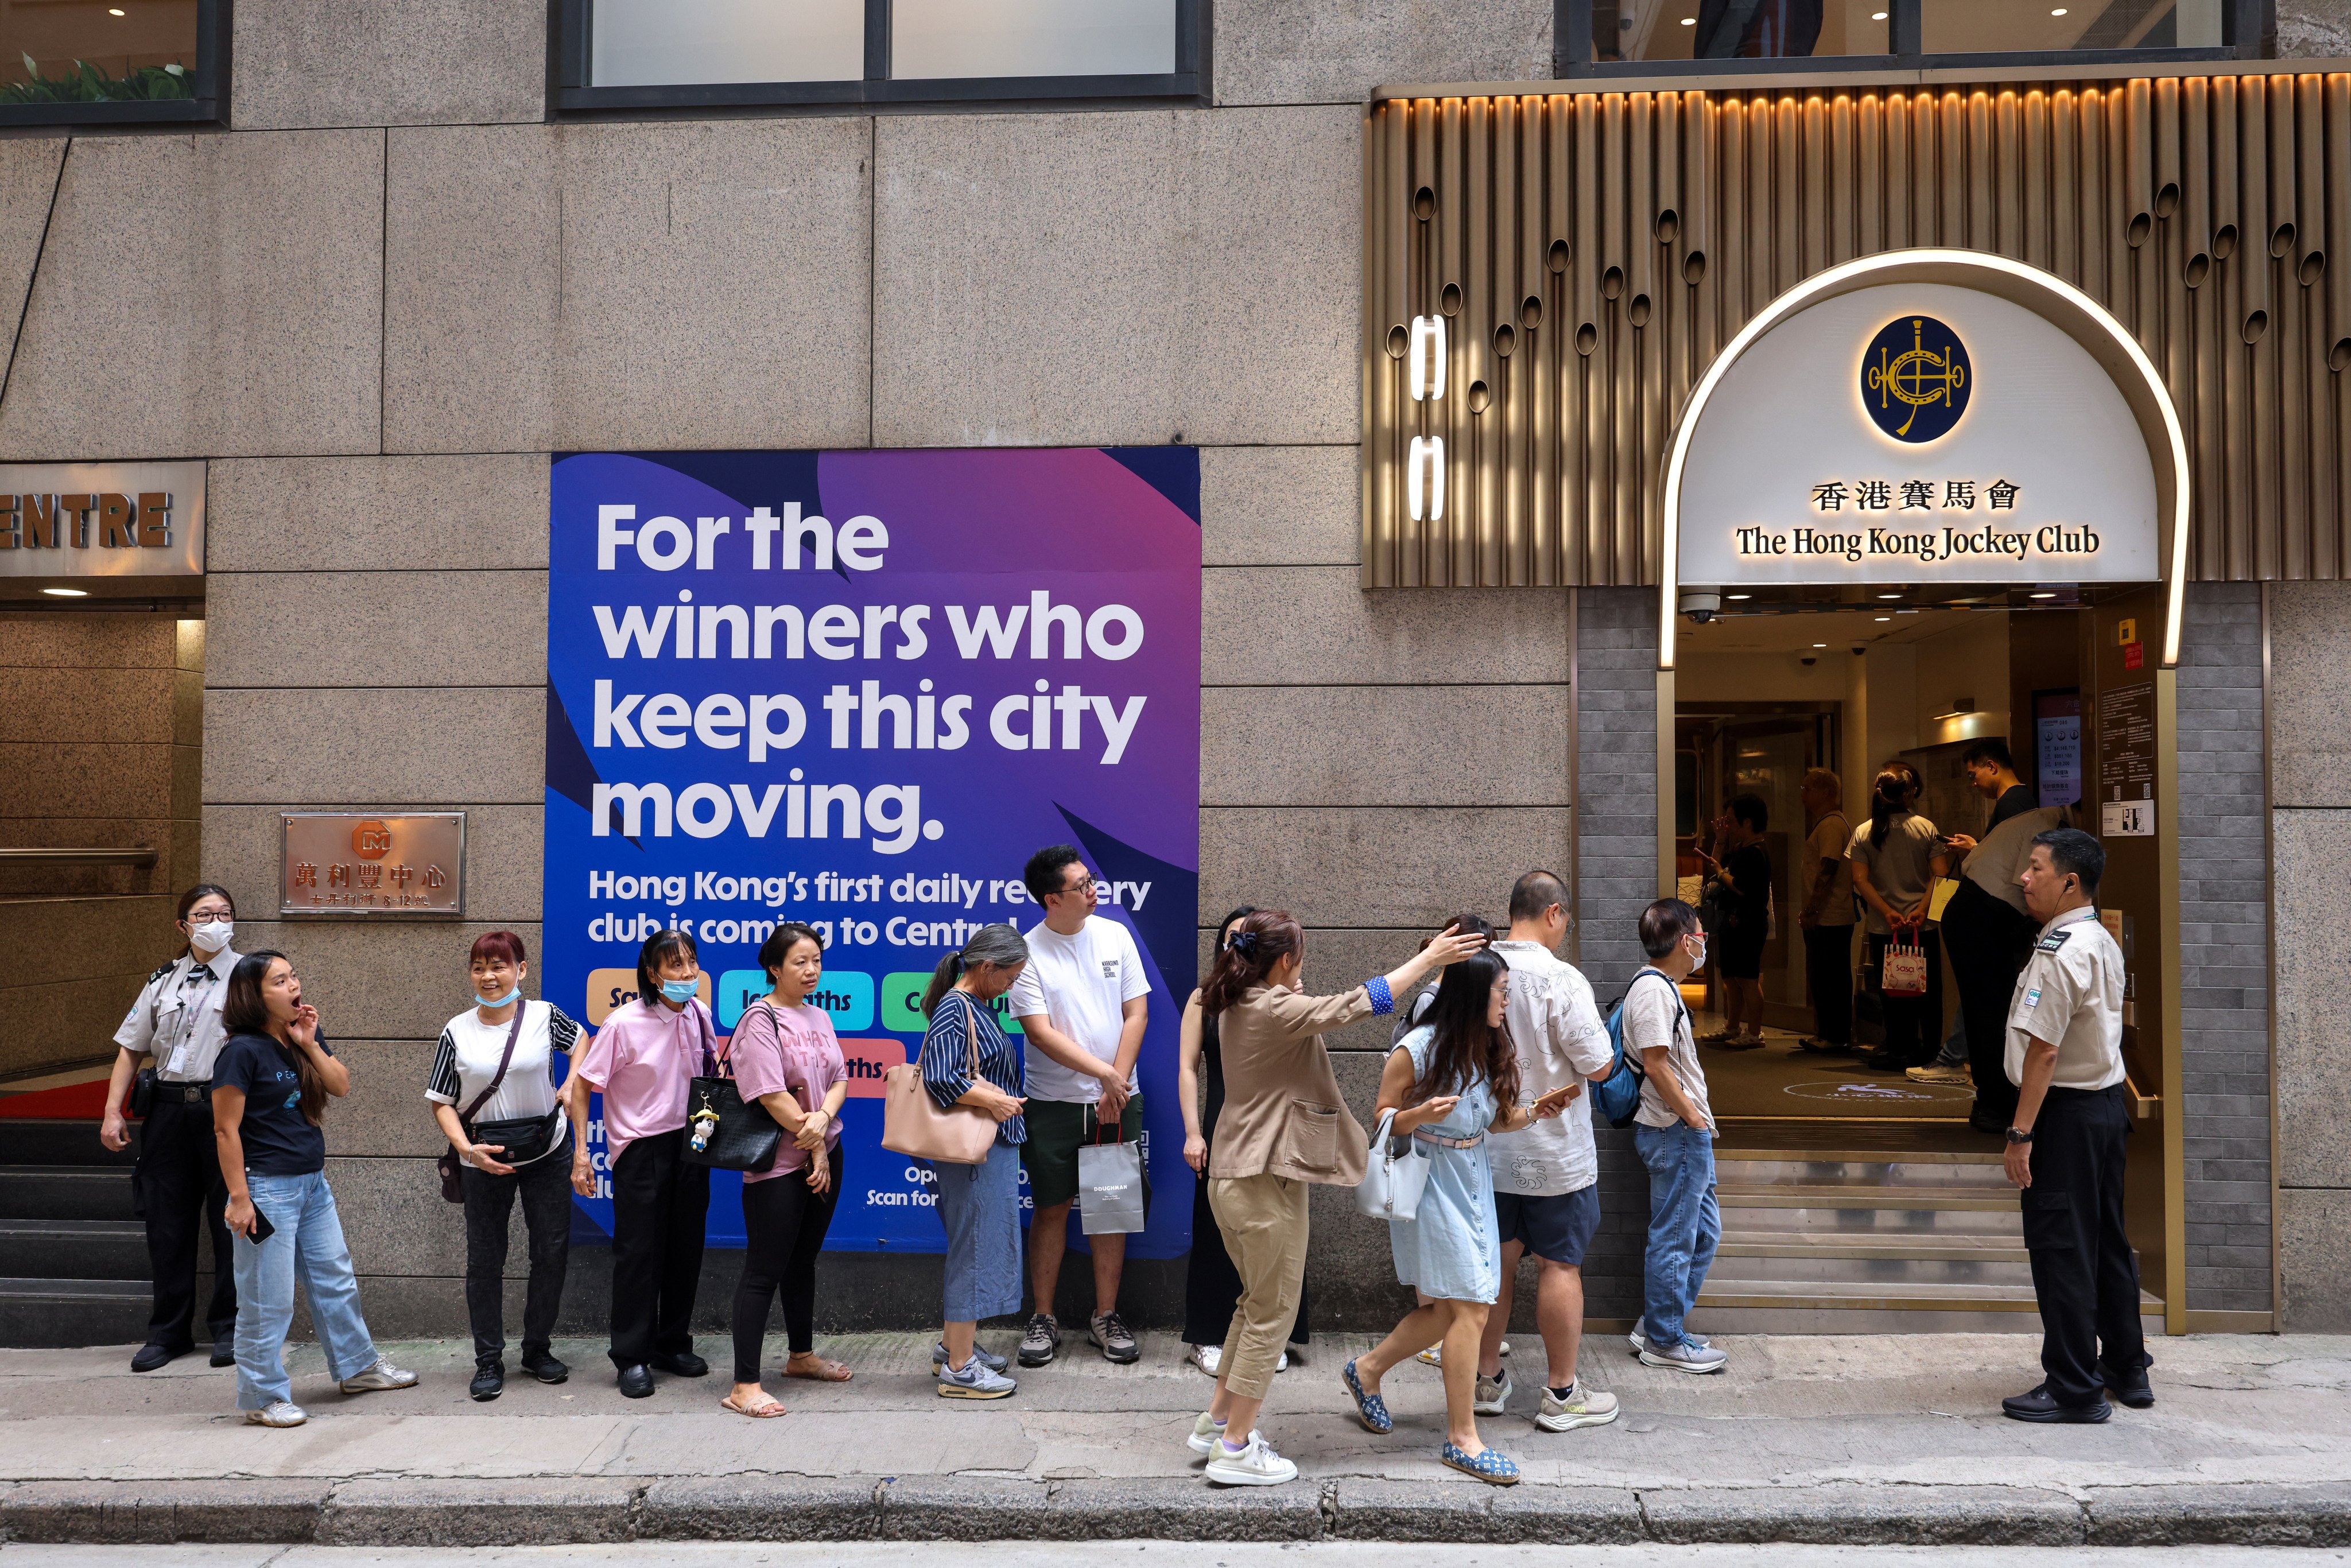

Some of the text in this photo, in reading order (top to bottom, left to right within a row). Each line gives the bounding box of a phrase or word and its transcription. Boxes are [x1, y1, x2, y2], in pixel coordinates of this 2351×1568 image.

[1811, 479, 2022, 511] 香港賽馬會
[598, 502, 889, 572] For the
[1736, 524, 2099, 562] The Hong Kong Jockey Club
[592, 589, 1144, 661] winners who
[593, 678, 1148, 764] keep this city
[592, 767, 944, 855] moving.
[296, 862, 446, 890] 萬利豐中心
[589, 870, 686, 906] Hong
[814, 871, 884, 902] first
[890, 872, 984, 909] daily
[990, 880, 1152, 911] reery
[588, 913, 662, 942] club
[669, 913, 693, 936] is
[700, 914, 833, 950] comg
[840, 917, 878, 945] to
[781, 1030, 831, 1048] WHAT
[867, 1189, 939, 1206] Scan for
[1093, 1184, 1128, 1192] DOUGHMAN
[1563, 1404, 1586, 1414] HOKA
